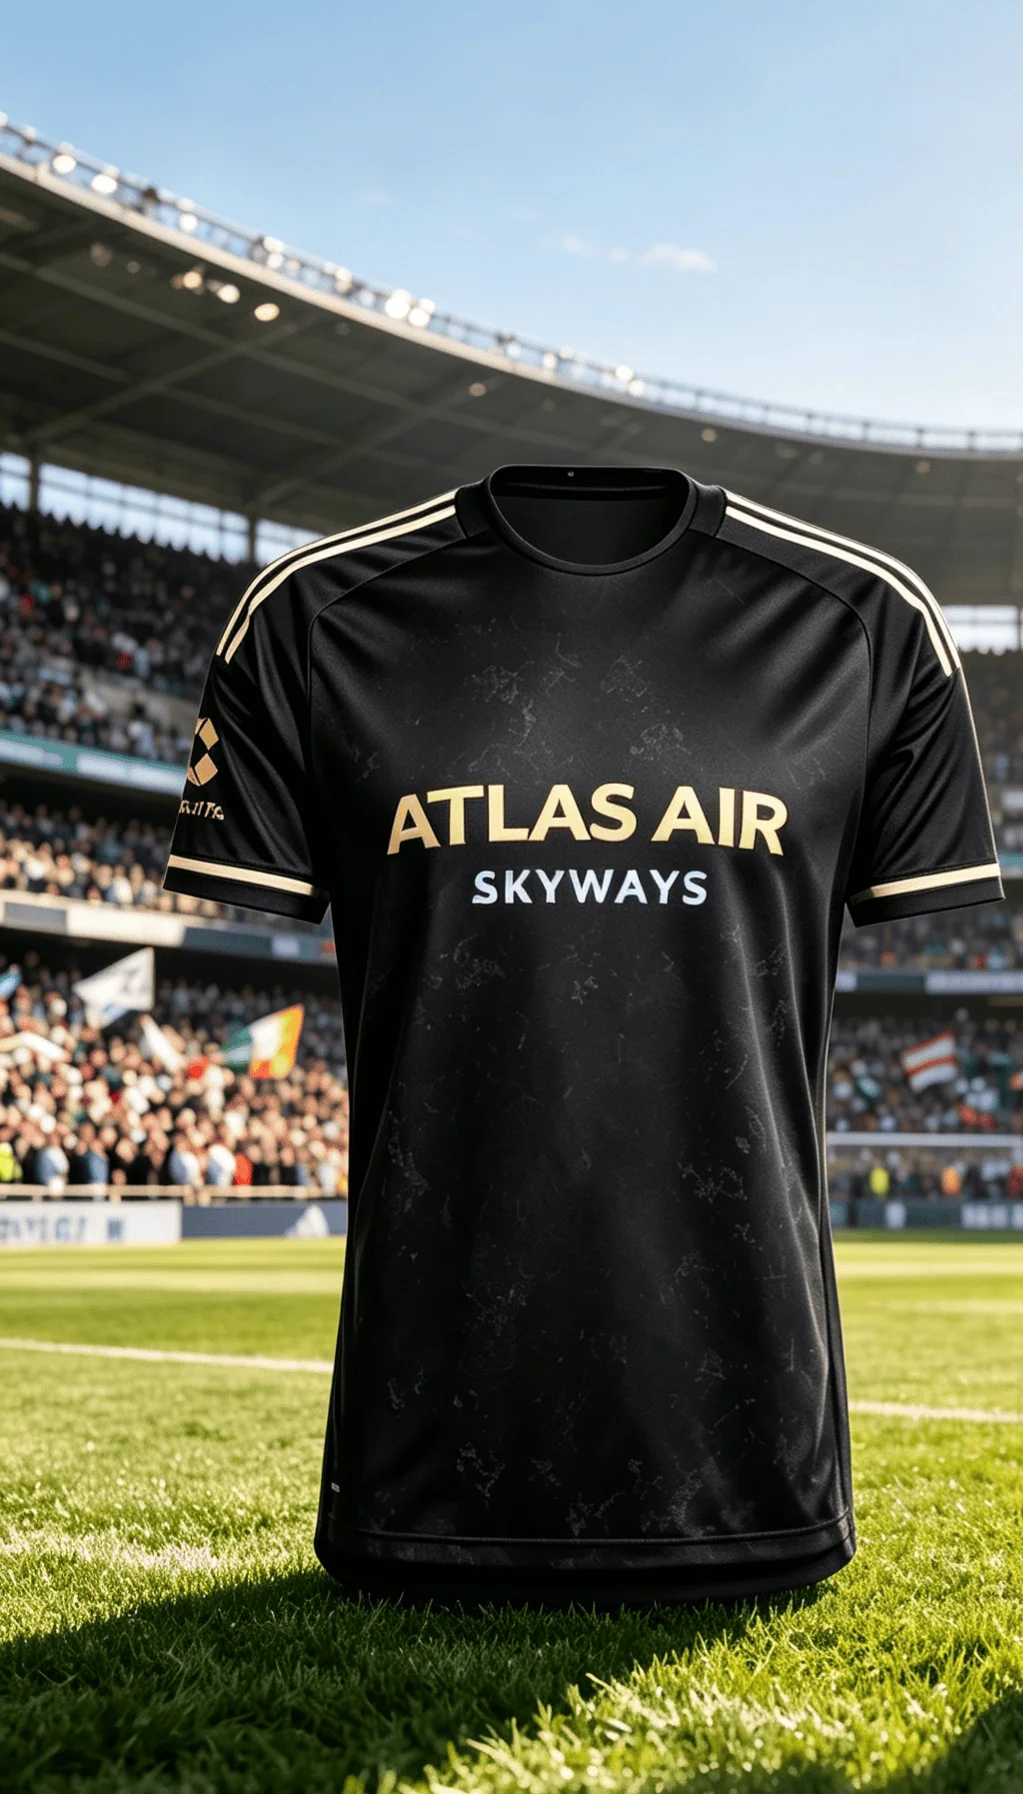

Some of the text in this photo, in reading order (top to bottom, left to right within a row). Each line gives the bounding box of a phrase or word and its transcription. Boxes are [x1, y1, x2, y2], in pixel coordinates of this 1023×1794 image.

[388, 783, 787, 855] ATLAS AIR
[472, 869, 707, 905] SKYWAYS
